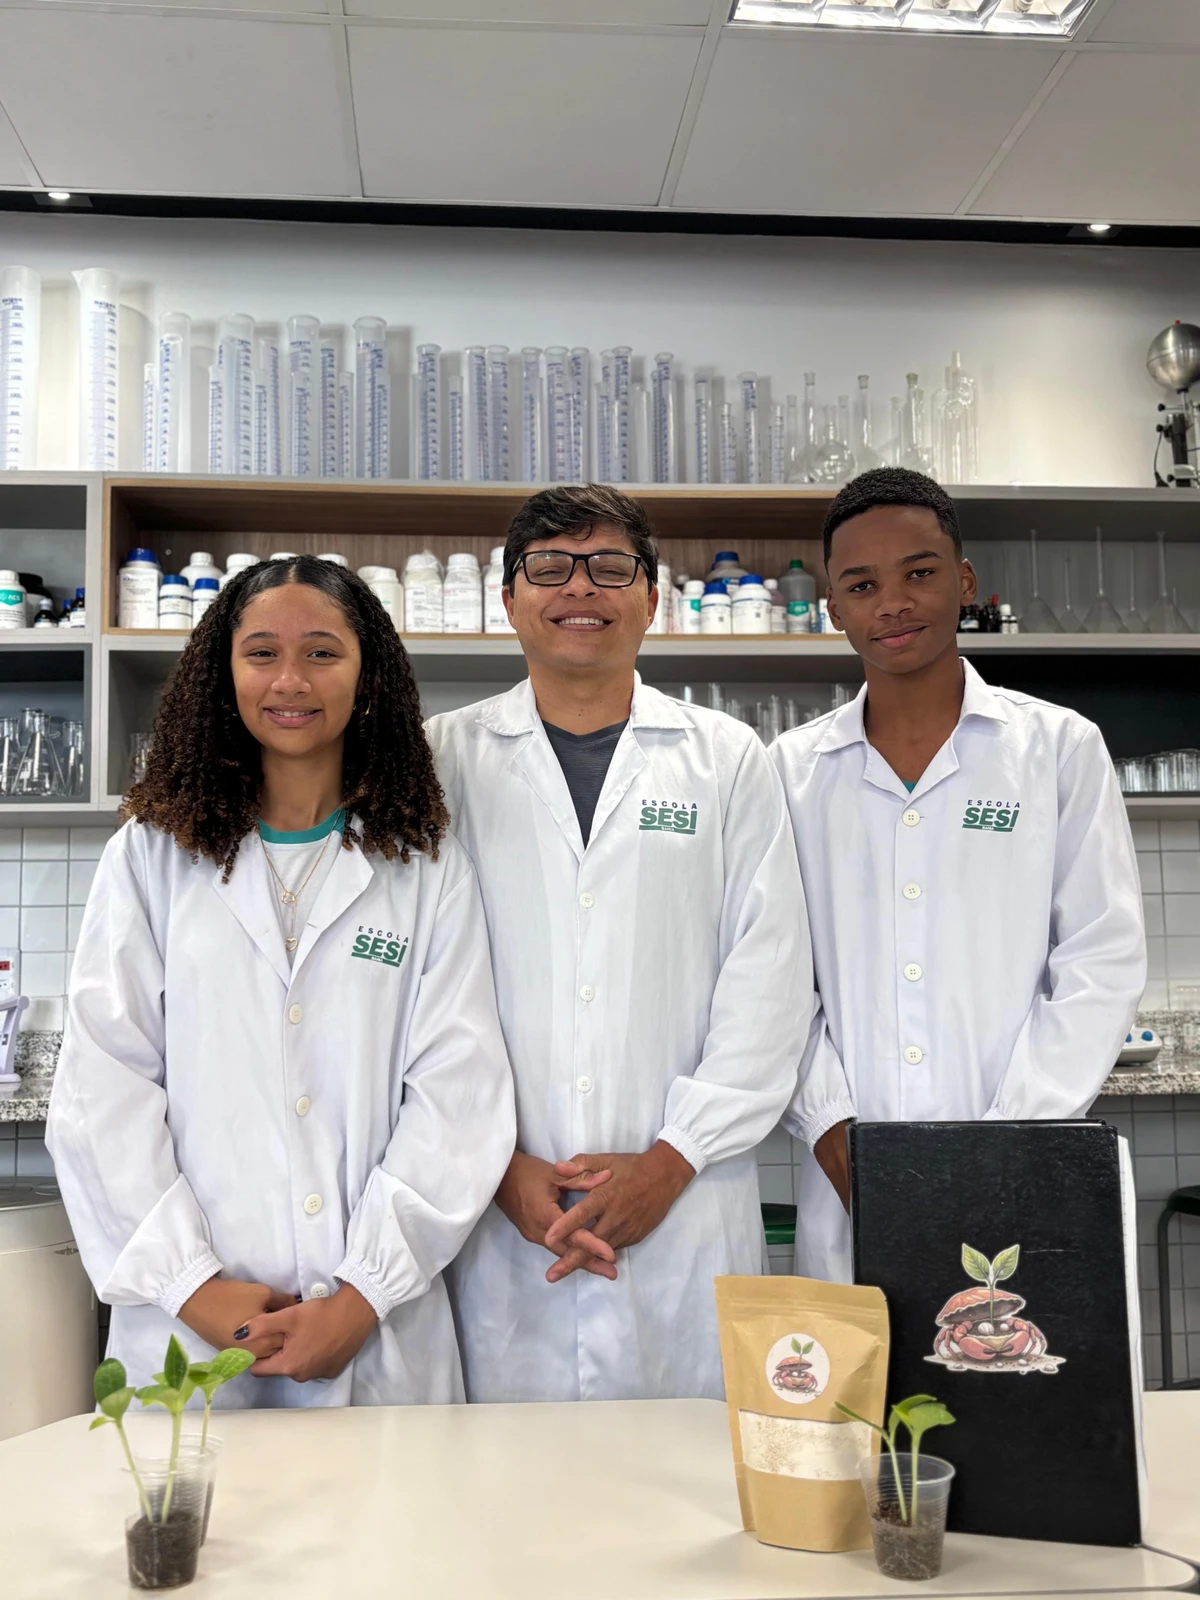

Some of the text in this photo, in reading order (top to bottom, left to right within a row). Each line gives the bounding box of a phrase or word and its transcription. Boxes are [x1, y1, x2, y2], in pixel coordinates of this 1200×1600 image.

[642, 799, 698, 810] ESCOLA
[967, 799, 1020, 808] ESCOLA
[640, 806, 698, 830] SESI
[962, 806, 1020, 828] SESI
[358, 925, 409, 943] ESCOLA
[352, 934, 407, 964] SESI
